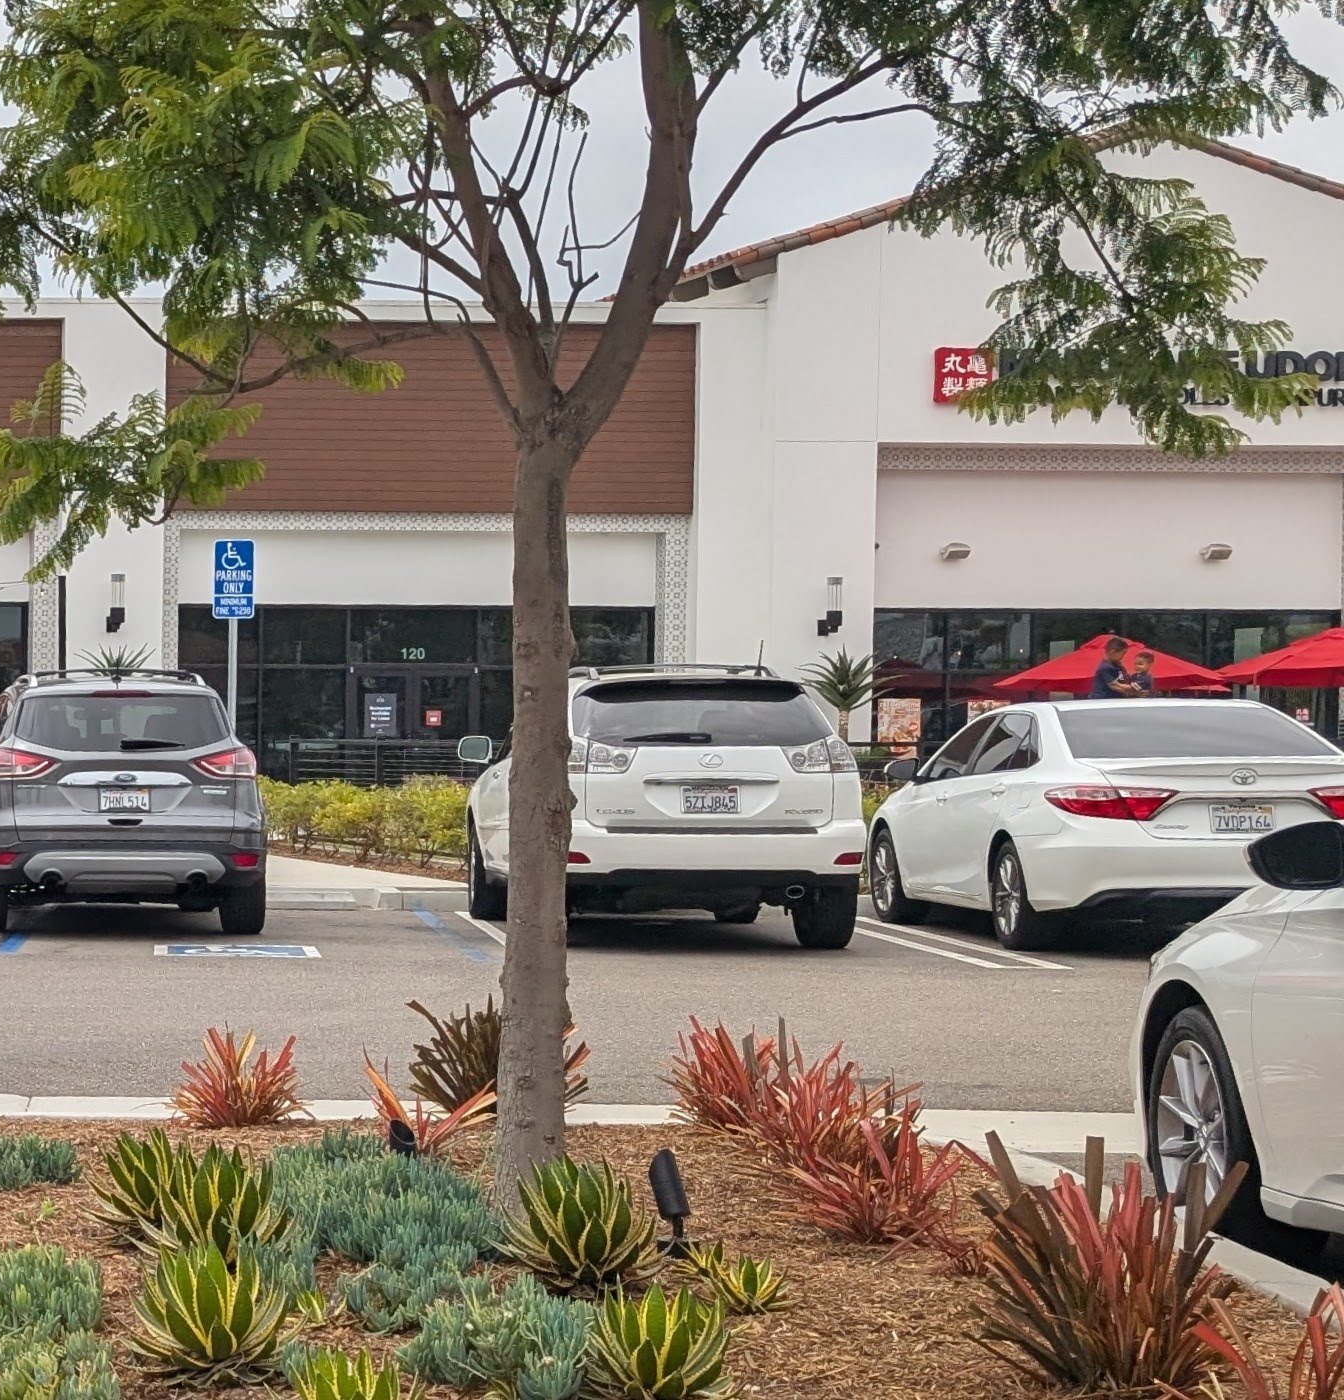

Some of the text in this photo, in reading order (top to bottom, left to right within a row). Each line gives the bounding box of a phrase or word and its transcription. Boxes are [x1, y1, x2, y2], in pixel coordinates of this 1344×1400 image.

[216, 570, 252, 581] PARKING
[223, 582, 244, 593] ONLY
[400, 647, 425, 660] 120
